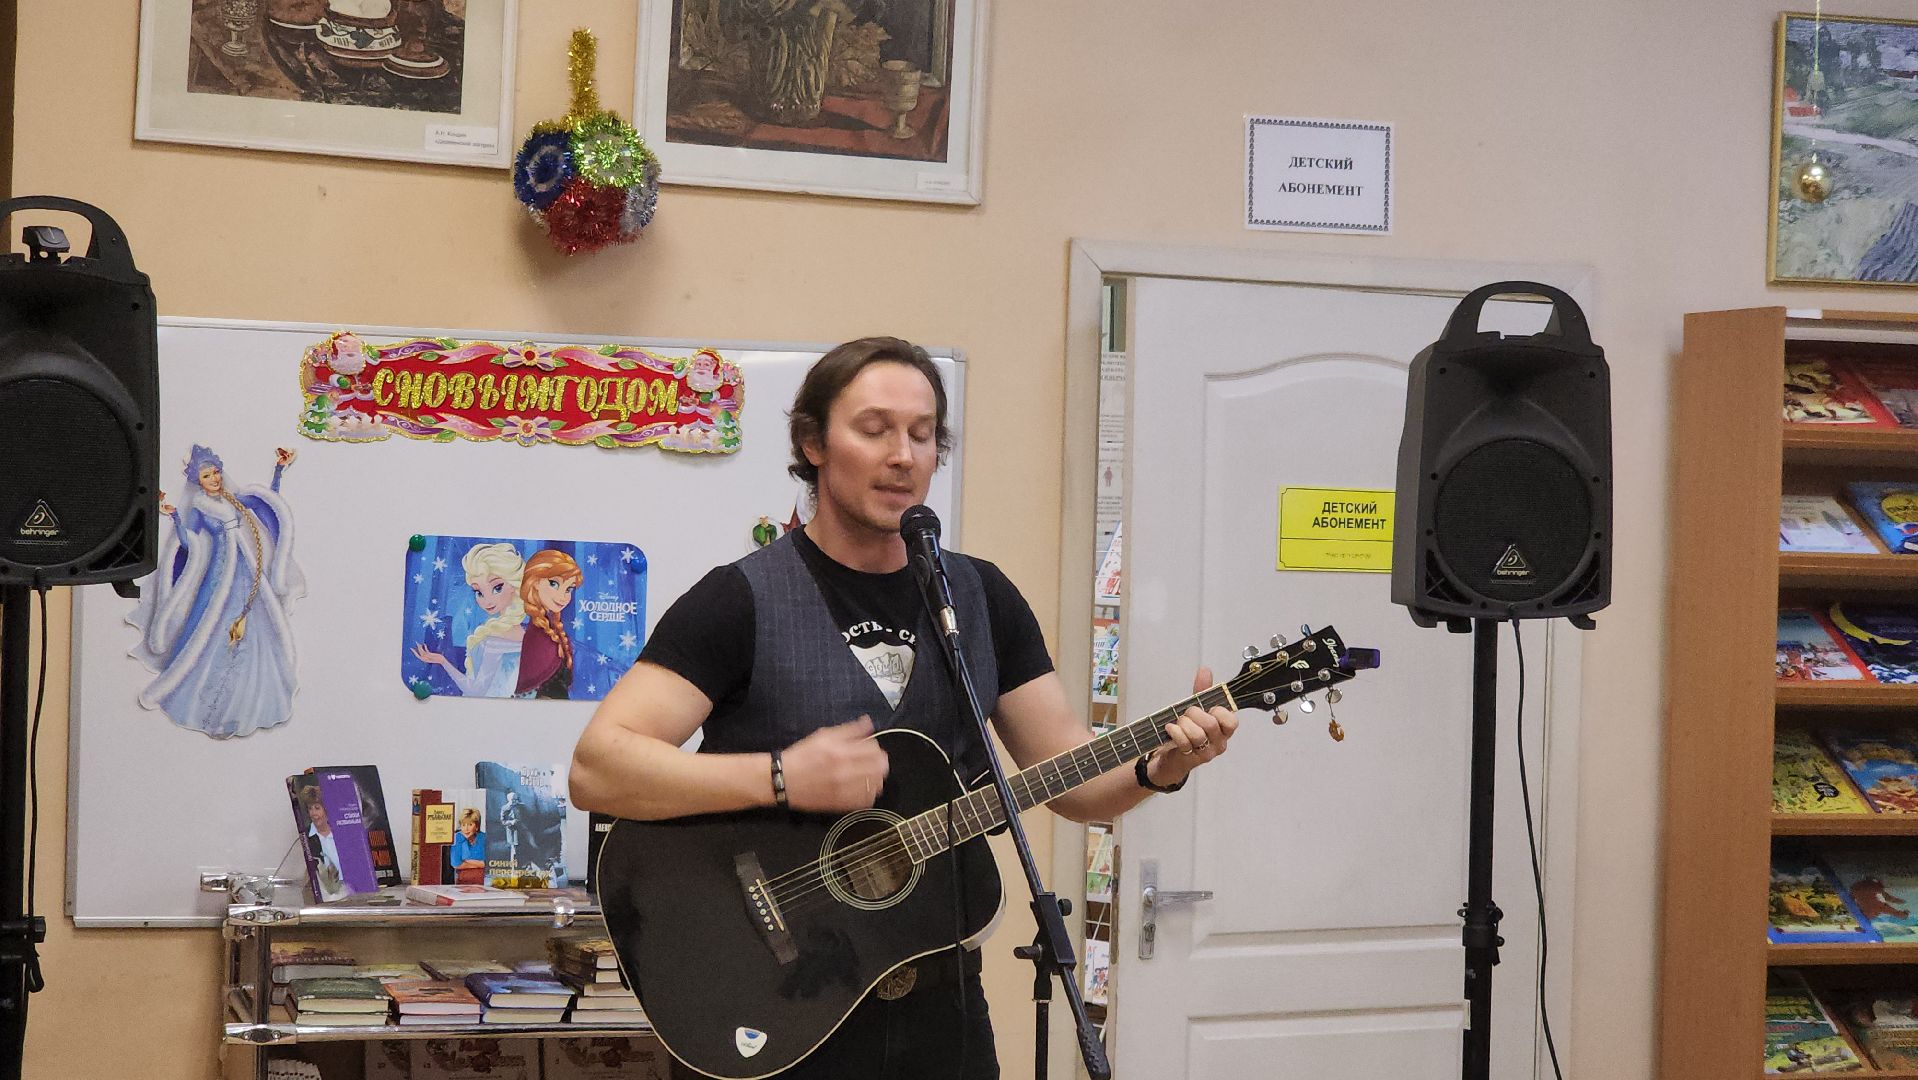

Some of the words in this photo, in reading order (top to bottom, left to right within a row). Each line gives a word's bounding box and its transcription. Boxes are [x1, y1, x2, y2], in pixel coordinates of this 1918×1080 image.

[1288, 156, 1353, 171] ДЕТСКИЙ
[1278, 182, 1363, 197] АБОНЕМЕНТ
[1321, 501, 1377, 515] ДЕТСКИЙ
[1312, 517, 1387, 530] АБОНЕМЕНТ
[20, 528, 59, 538] behringer
[1496, 569, 1530, 577] behringer
[578, 599, 638, 615] ХОЛОДНОЕ
[588, 611, 626, 623] СЕРДЦЕ
